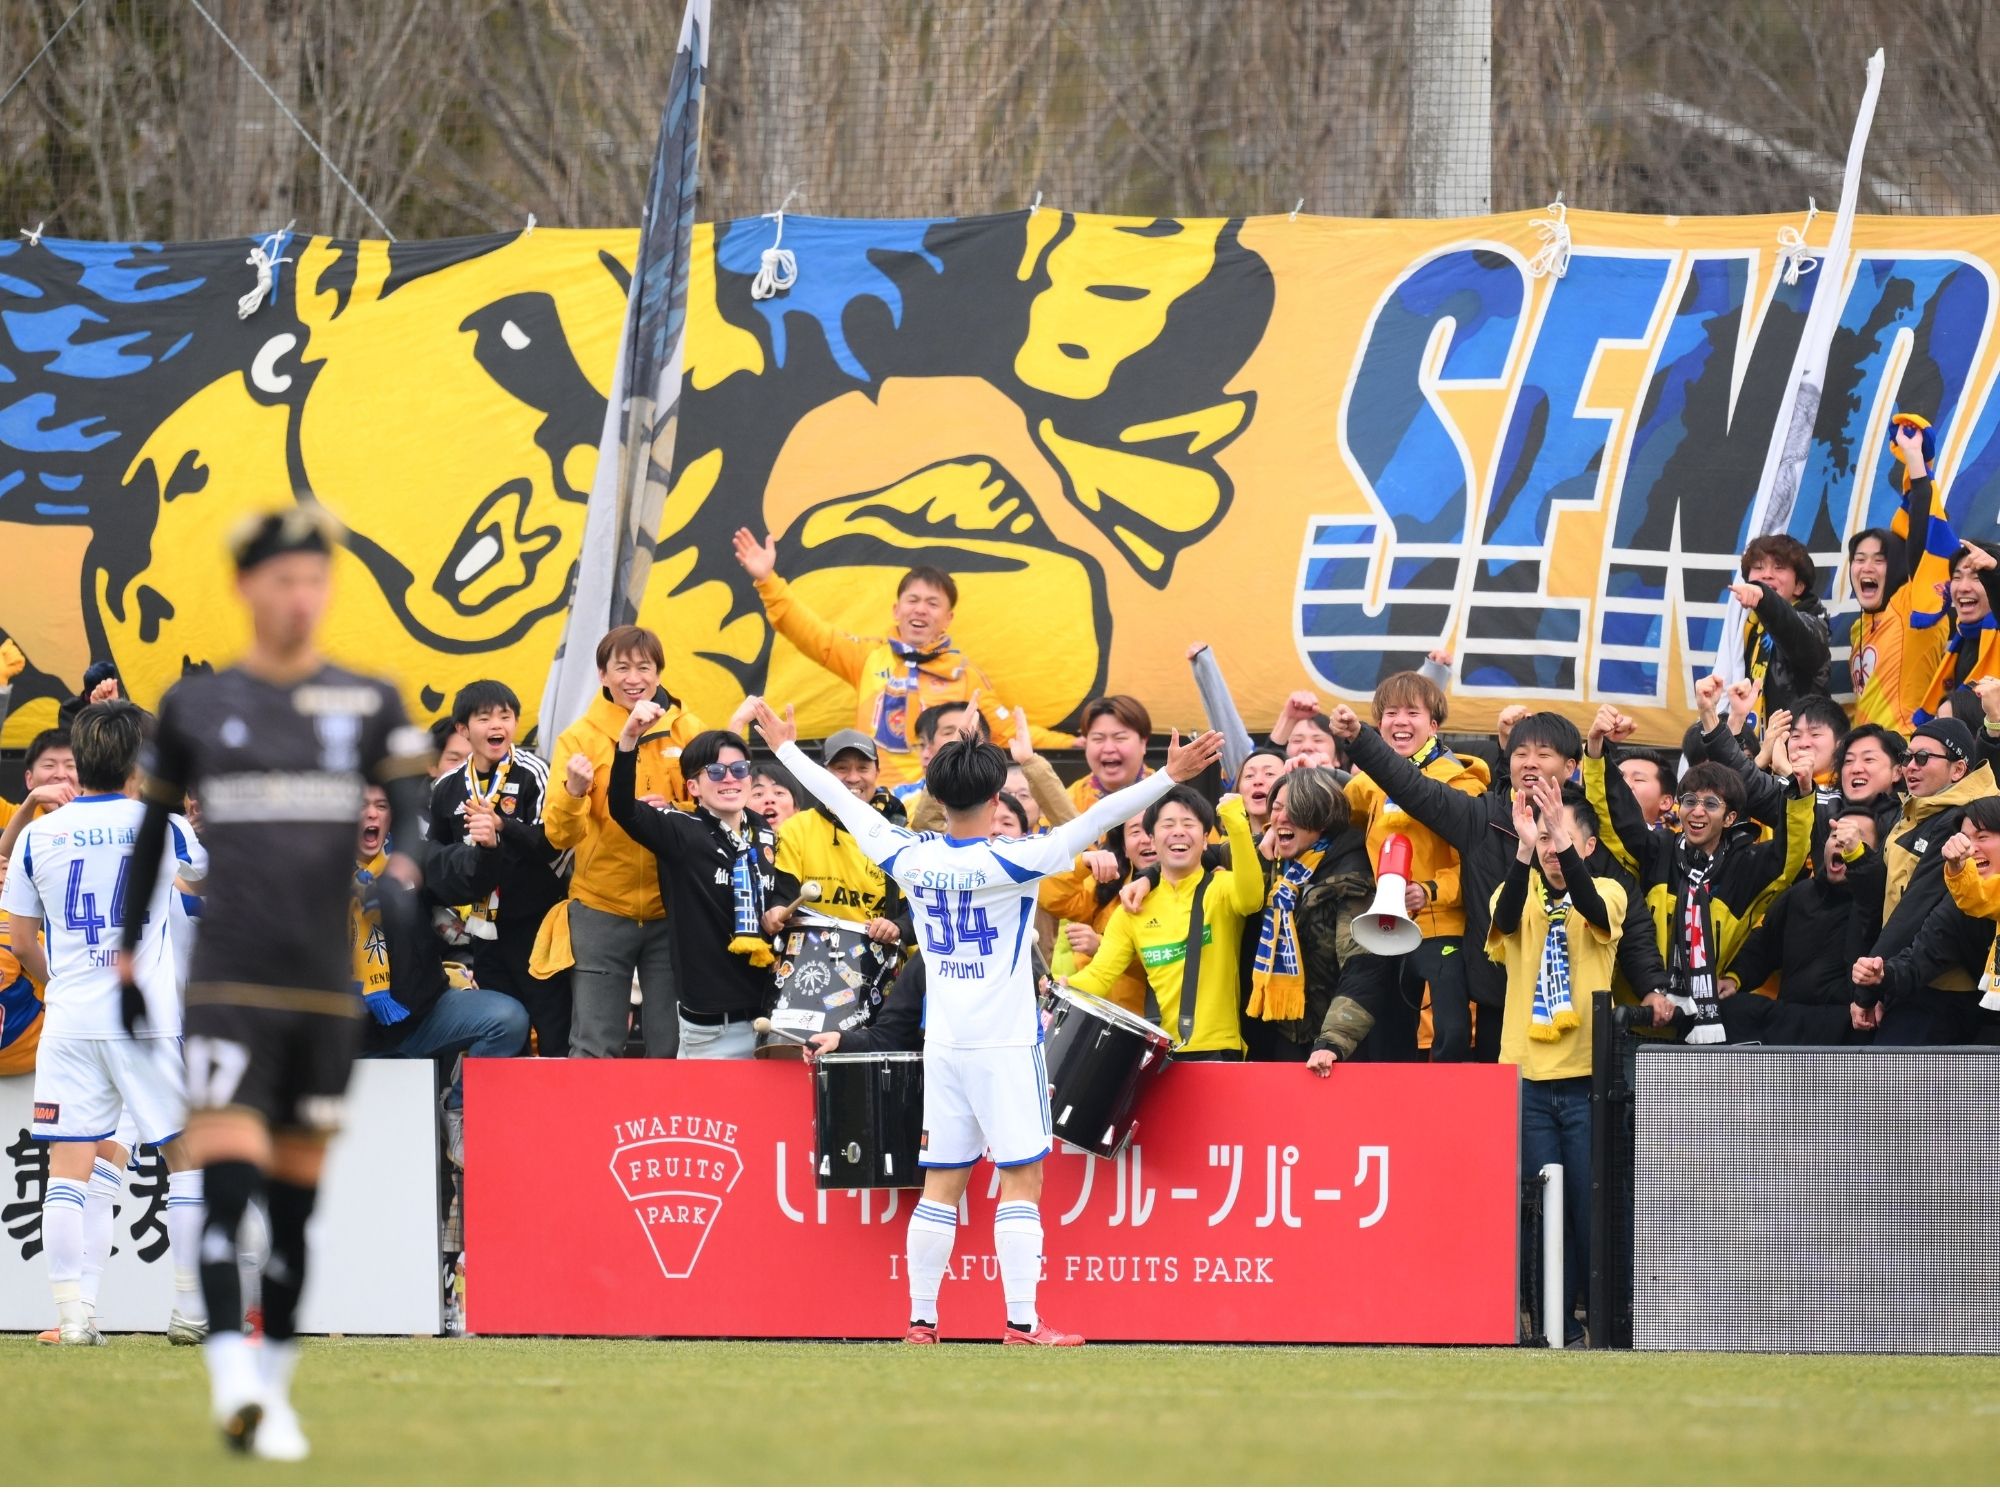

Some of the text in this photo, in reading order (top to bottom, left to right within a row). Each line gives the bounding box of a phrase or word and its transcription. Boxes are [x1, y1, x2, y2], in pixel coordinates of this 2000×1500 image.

[73, 827, 138, 848] SBI証
[914, 885, 999, 956] 34
[939, 960, 985, 979] AYUMU
[614, 1115, 738, 1145] IWAFUNE
[629, 1157, 726, 1182] FRUITS
[647, 1205, 707, 1225] PARK
[1065, 1256, 1178, 1282] FRUITS
[1193, 1257, 1274, 1283] PARK
